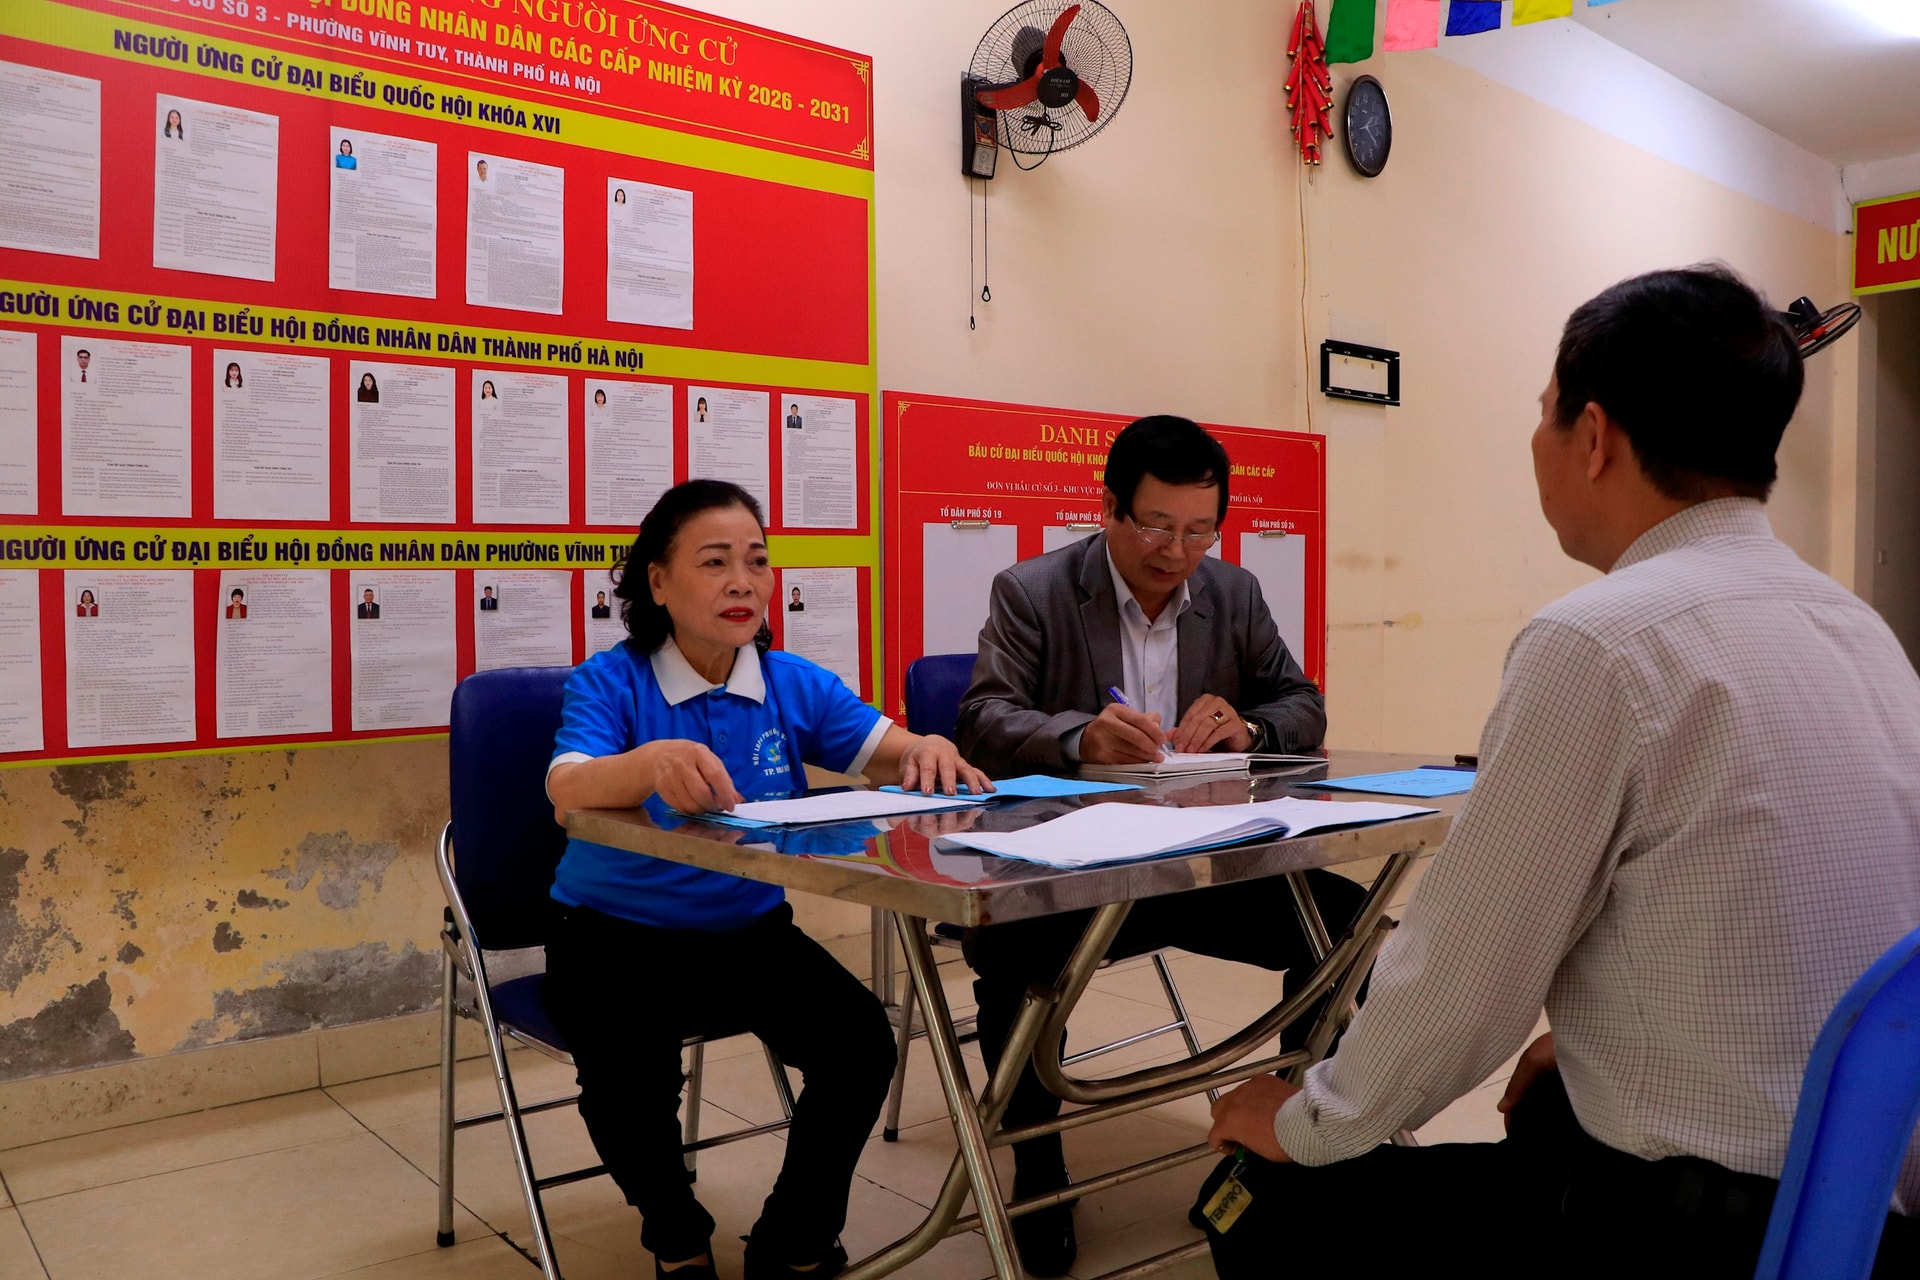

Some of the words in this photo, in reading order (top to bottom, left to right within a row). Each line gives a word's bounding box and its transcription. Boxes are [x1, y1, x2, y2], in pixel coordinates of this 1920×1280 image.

[255, 5, 267, 22] 3
[286, 12, 363, 43] PHƯỜNG
[369, 29, 410, 54] VĨNH
[415, 40, 449, 63] TUY,
[454, 48, 508, 74] THÀNH
[513, 62, 545, 82] PHỐ
[549, 69, 570, 88] HÀ
[574, 75, 600, 96] NỘI
[512, 0, 618, 38] NGƯỜI
[627, 13, 690, 55] ỨNG
[699, 35, 738, 66] CỬ
[114, 29, 188, 63] NGƯỜI
[197, 43, 244, 74] ỨNG
[251, 55, 283, 81] CỬ
[287, 65, 322, 92] ĐẠI
[329, 72, 376, 99] BIỂU
[383, 84, 435, 110] QUỐC
[441, 95, 472, 120] HỘI
[478, 103, 527, 129] KHÓA
[532, 113, 560, 135] XVI
[420, 6, 487, 42] NHÂN
[495, 23, 542, 55] DÂN
[550, 35, 593, 65] CÁC
[600, 46, 641, 76] CẤP
[648, 59, 713, 93] NHIỆM
[719, 76, 743, 99] KỲ
[748, 84, 793, 111] 2026
[810, 98, 849, 124] 2031
[1877, 219, 1920, 264] NƯ
[68, 294, 119, 323] ỨNG
[127, 299, 162, 327] CỬ
[166, 308, 205, 334] ĐẠI
[213, 307, 264, 335] BIỂU
[270, 316, 306, 343] HỘI
[313, 317, 369, 346] ĐỒNG
[376, 326, 431, 351] NHÂN
[437, 331, 477, 355] DÂN
[482, 335, 542, 360] THÀNH
[547, 340, 582, 364] PHỐ
[587, 346, 610, 367] HÀ
[615, 348, 644, 369] NỘI
[990, 443, 1003, 459] CỬ
[1004, 448, 1020, 462] ĐẠI
[1045, 448, 1068, 463] QUỐC
[1070, 450, 1084, 466] HỘI
[1040, 424, 1099, 447] DANH
[1247, 464, 1260, 477] CÁC
[1063, 486, 1078, 494] KHU
[950, 507, 965, 517] DÂN
[966, 506, 980, 518] PHỐ
[982, 507, 992, 518] SỐ
[993, 510, 1002, 518] 19
[0, 534, 66, 561] GƯỜI
[74, 535, 126, 561] ỨNG
[133, 534, 167, 562] CỬ
[171, 541, 210, 565] ĐẠI
[218, 534, 268, 562] BIỂU
[274, 538, 310, 565] HỘI
[317, 536, 374, 562] ĐỒNG
[379, 539, 435, 562] NHÂN
[440, 539, 480, 562] DÂN
[486, 540, 560, 562] PHƯỜNG
[564, 540, 605, 562] VĨNH
[610, 544, 632, 562] TU
